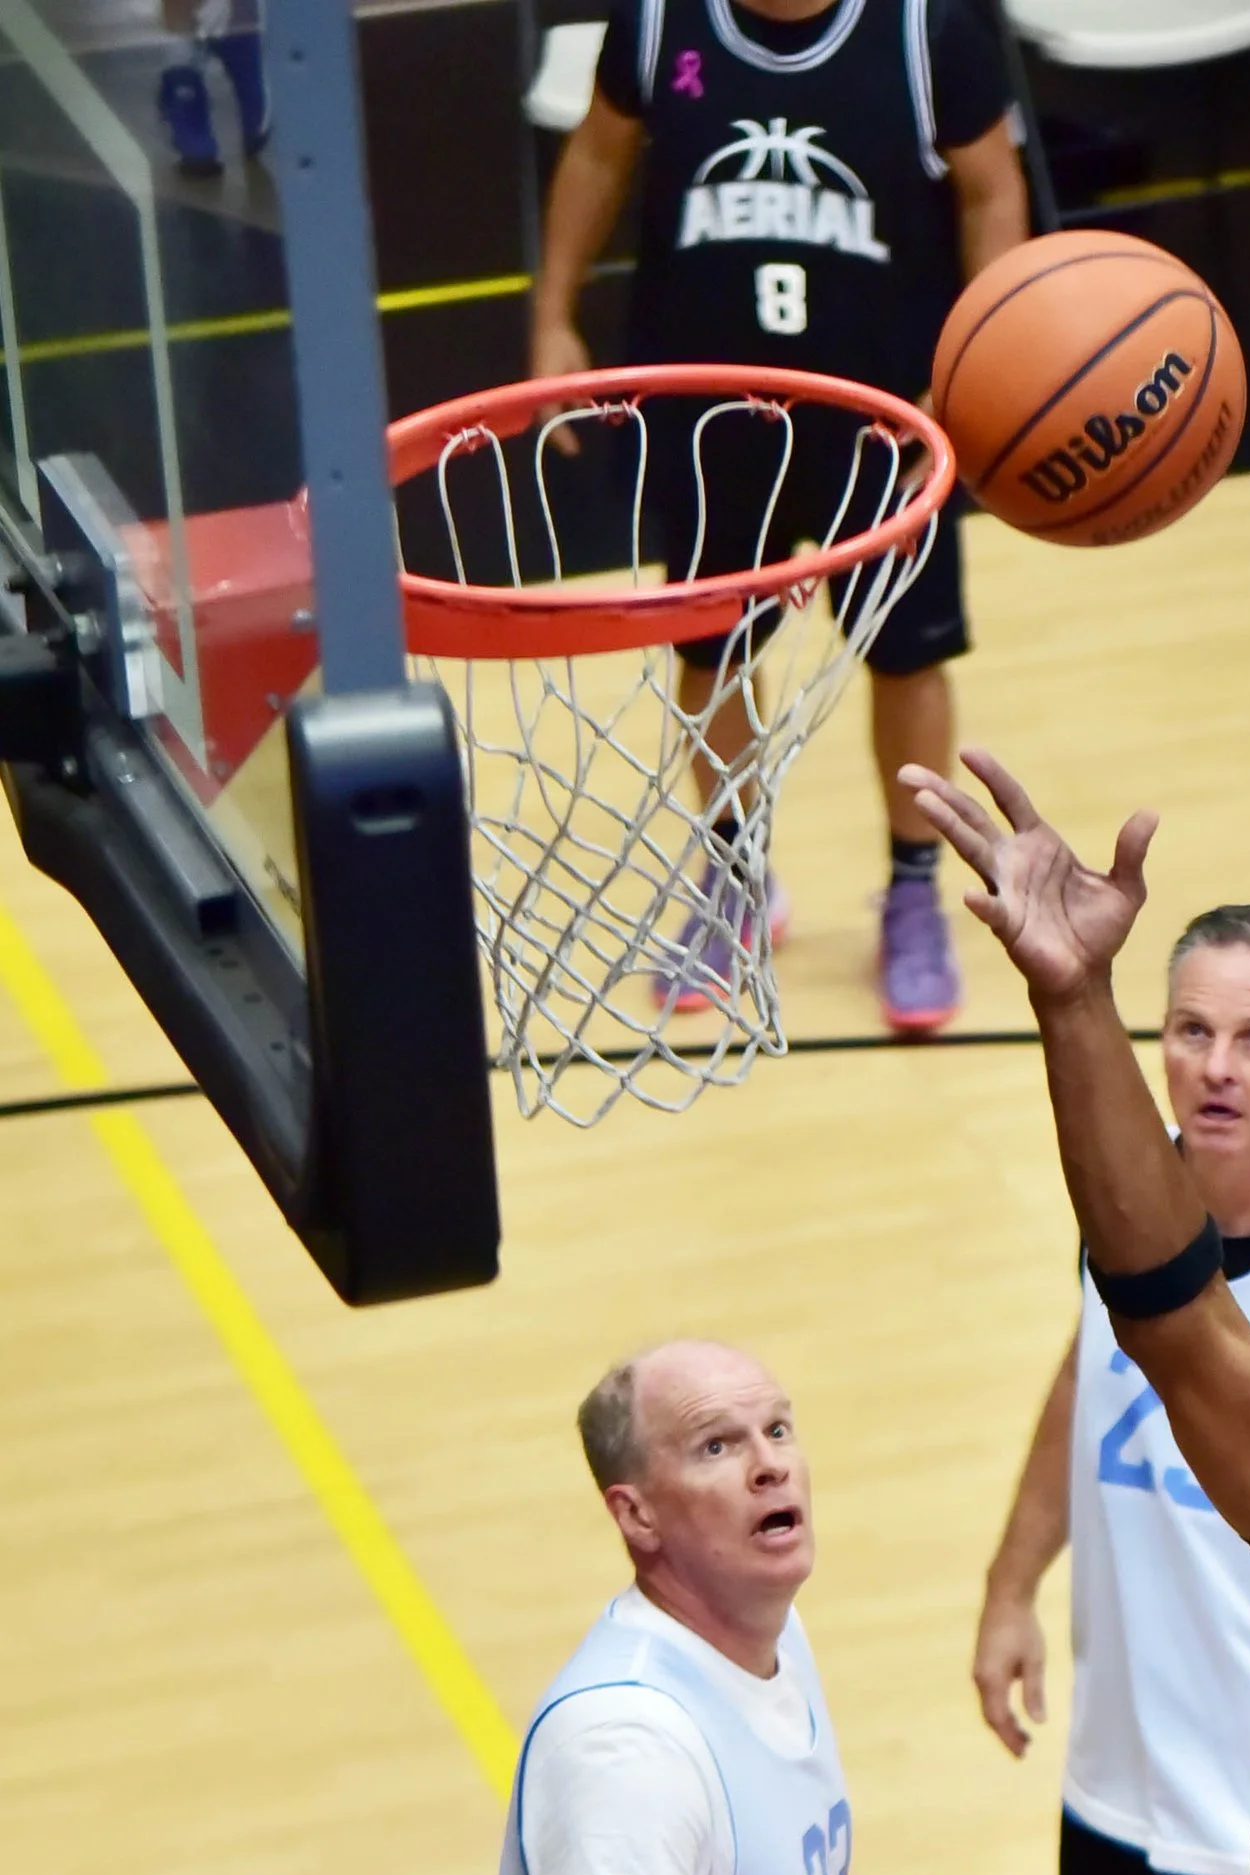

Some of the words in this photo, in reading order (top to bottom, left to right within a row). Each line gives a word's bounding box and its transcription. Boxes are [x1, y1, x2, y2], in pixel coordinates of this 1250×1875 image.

[676, 180, 891, 263] AERIAL
[754, 262, 807, 335] 8
[1018, 351, 1194, 505] Wilson
